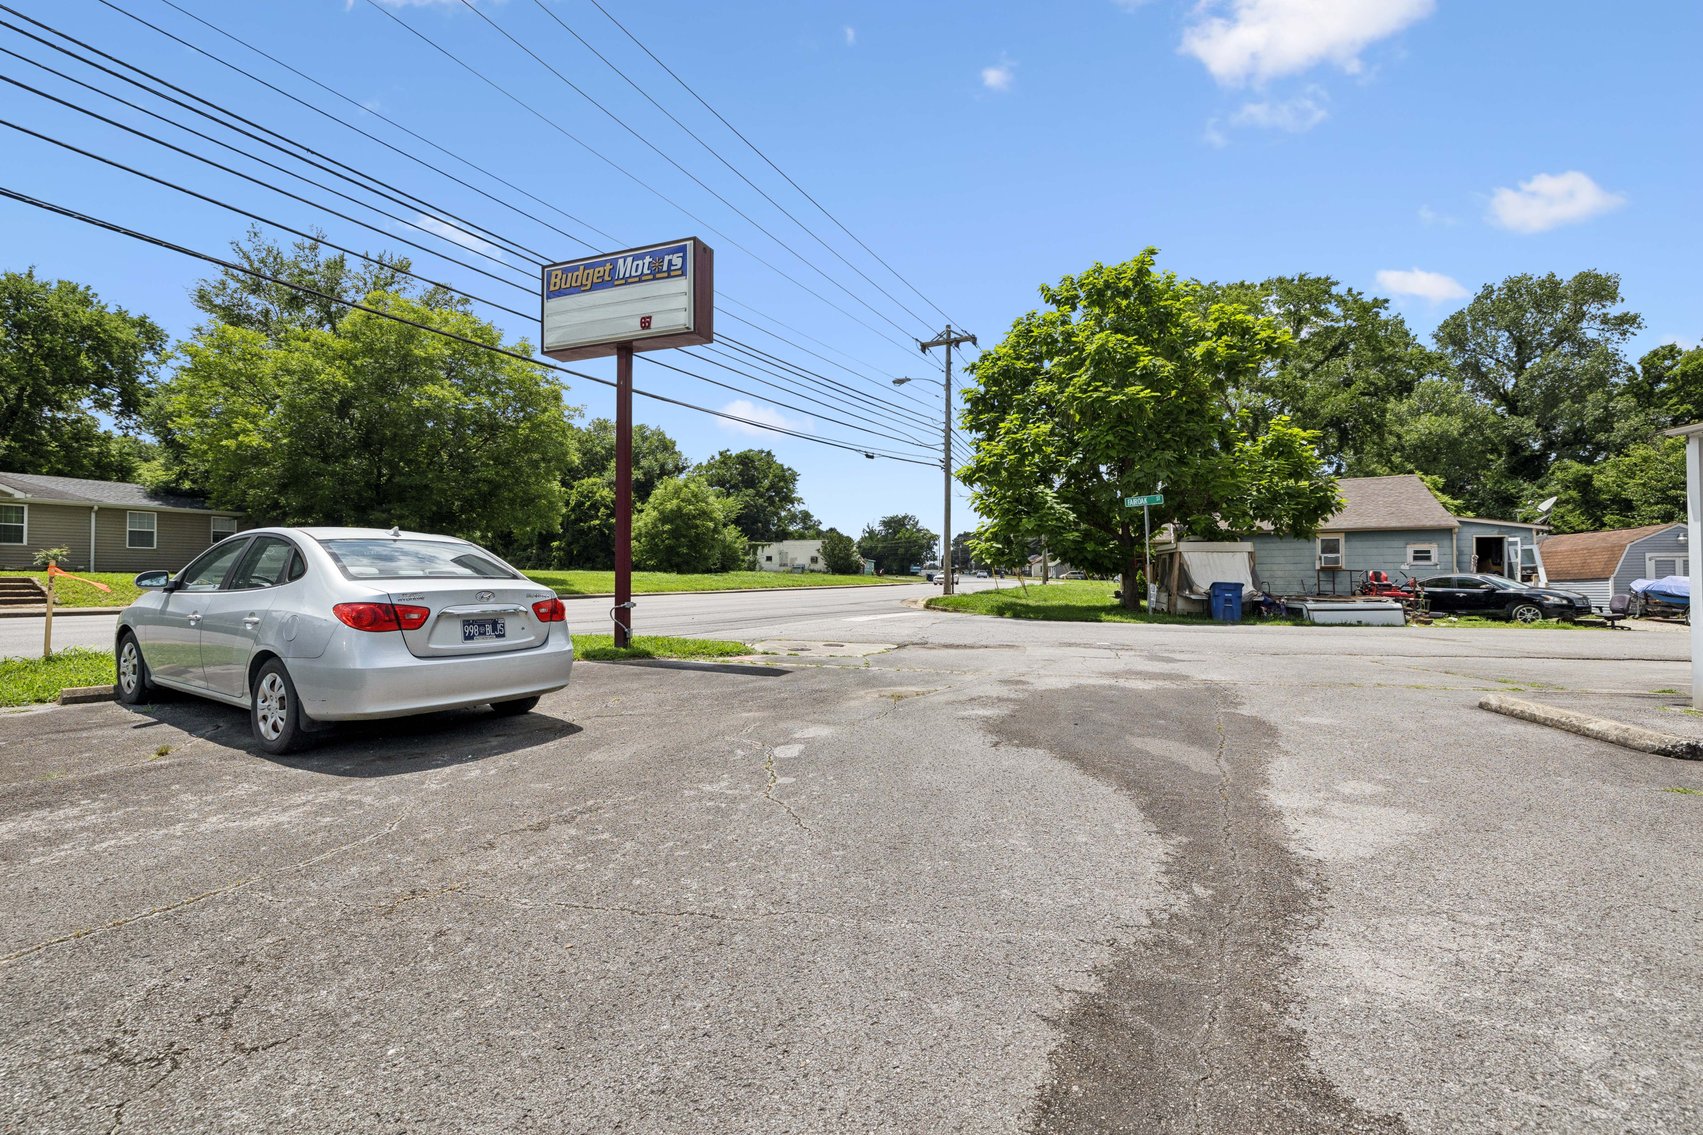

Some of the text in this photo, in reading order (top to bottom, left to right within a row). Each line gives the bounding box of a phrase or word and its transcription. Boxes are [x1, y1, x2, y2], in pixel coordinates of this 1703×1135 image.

[549, 252, 683, 291] Budget Motors
[1127, 497, 1148, 506] FAIROAK
[464, 624, 479, 636] 998
